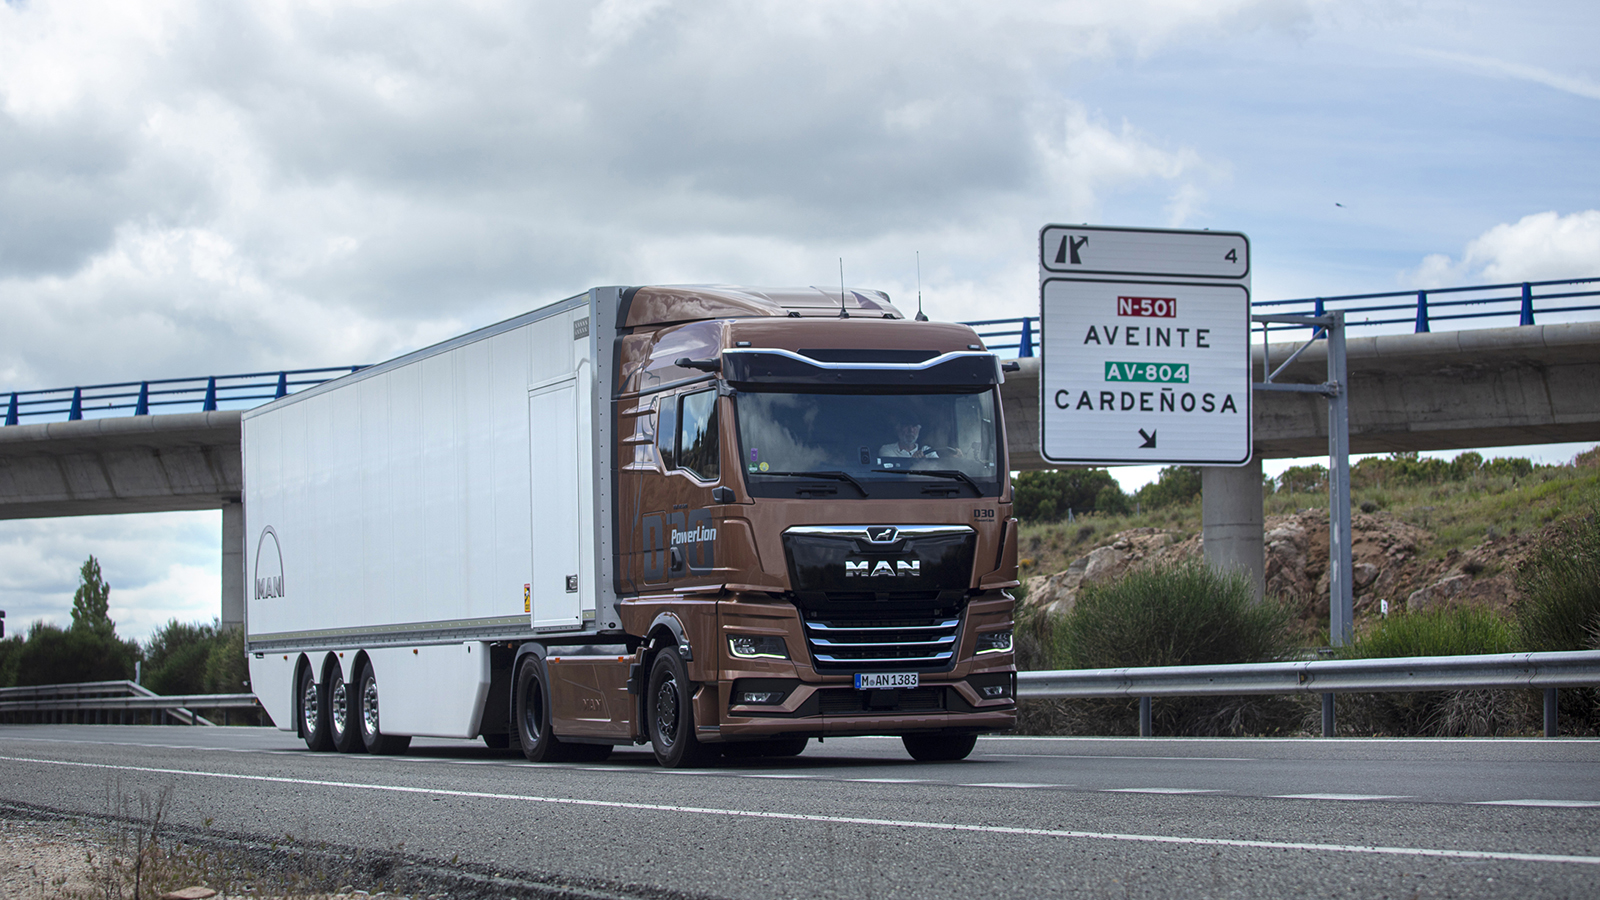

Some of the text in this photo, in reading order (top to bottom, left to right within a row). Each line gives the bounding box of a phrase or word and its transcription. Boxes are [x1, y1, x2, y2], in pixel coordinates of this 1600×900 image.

[1225, 249, 1238, 264] 4
[1118, 298, 1176, 316] N-501
[1084, 326, 1210, 348] AVEINTE
[1107, 364, 1188, 381] AV-804
[1055, 388, 1238, 414] CARDEÑOSA
[974, 509, 995, 518] D30
[671, 526, 717, 545] PowerLion
[845, 560, 920, 577] MAN
[257, 576, 281, 600] MAN
